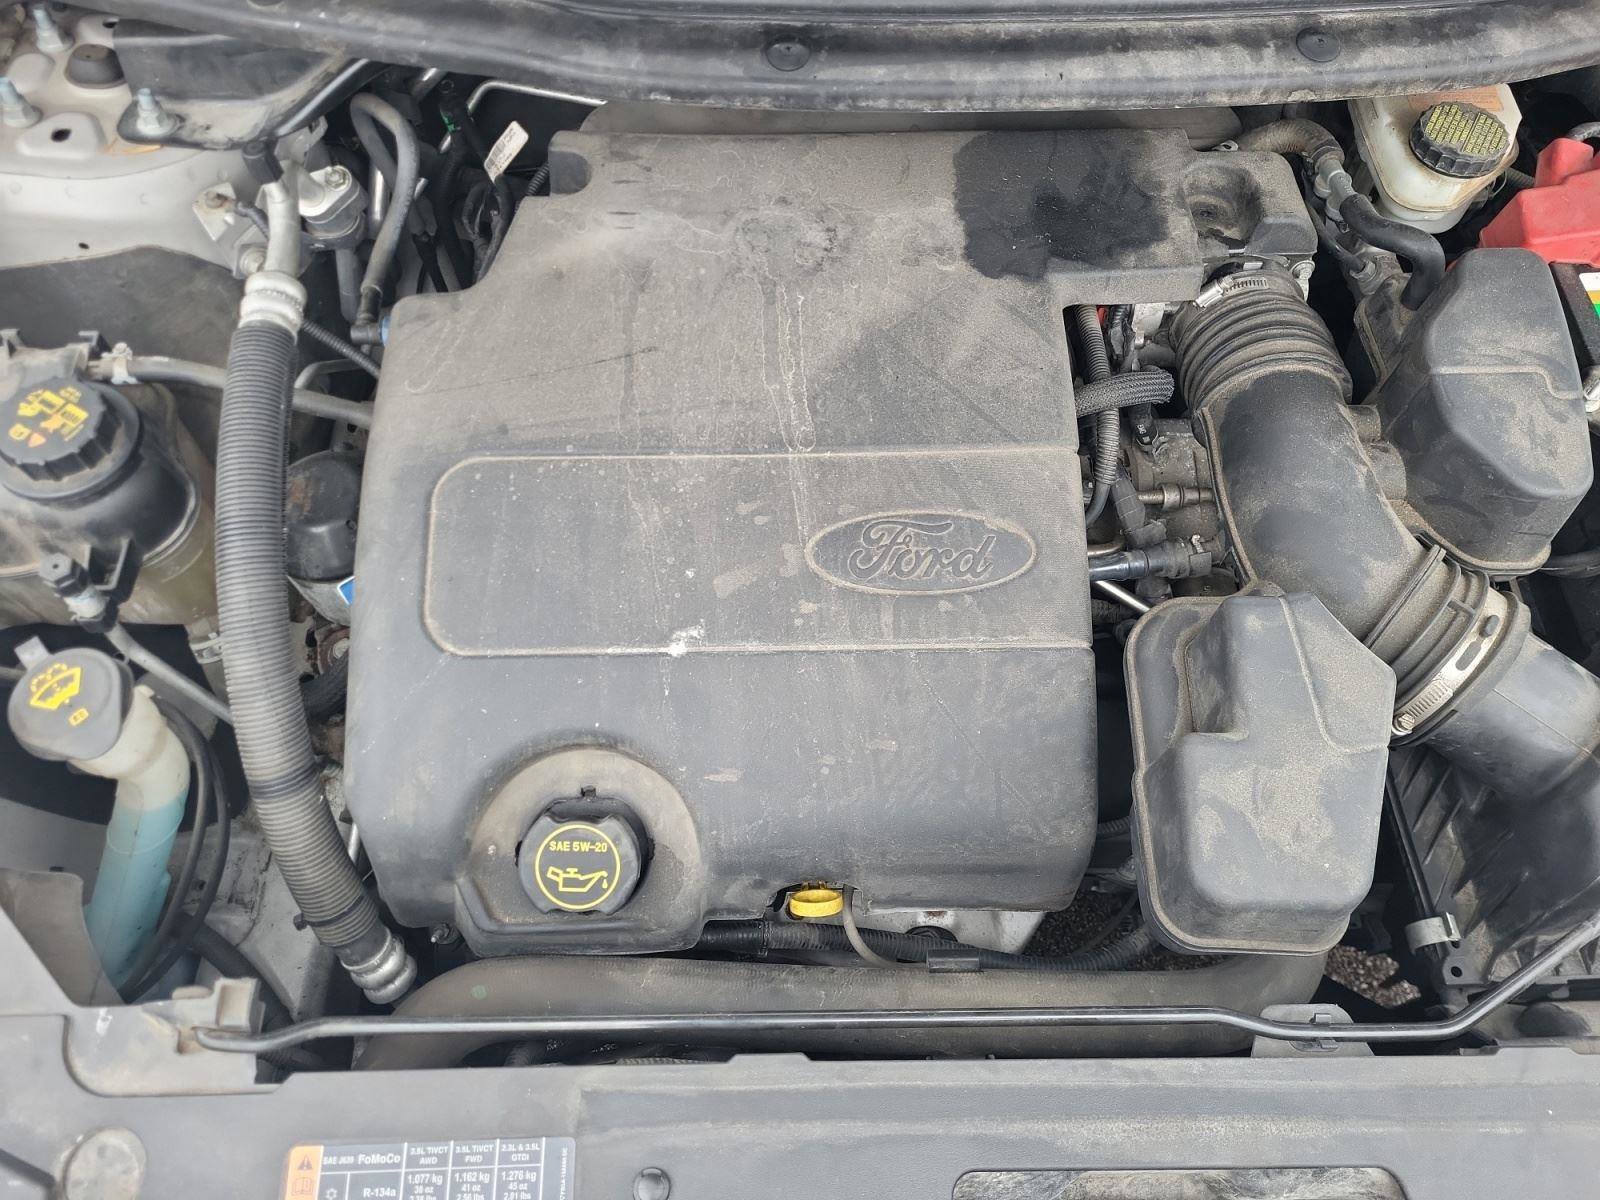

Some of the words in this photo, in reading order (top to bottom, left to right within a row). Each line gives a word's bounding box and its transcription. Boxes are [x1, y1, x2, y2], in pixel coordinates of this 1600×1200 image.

[848, 519, 997, 580] Ford
[549, 841, 570, 851] SAE
[572, 841, 608, 853] 5W-20
[323, 1156, 337, 1165] SAE
[358, 1153, 401, 1165] FoMoCo
[419, 1157, 438, 1165] AWD
[465, 1155, 483, 1163] FWD
[407, 1174, 430, 1184] 1.077
[432, 1173, 443, 1185] kg
[454, 1172, 477, 1183] 1.162
[479, 1171, 490, 1183] kg
[501, 1170, 524, 1181] 1.276
[525, 1170, 537, 1182] kg
[363, 1187, 397, 1198] R-134a
[424, 1186, 434, 1194] oz
[461, 1184, 470, 1192] 41
[472, 1184, 481, 1192] oz
